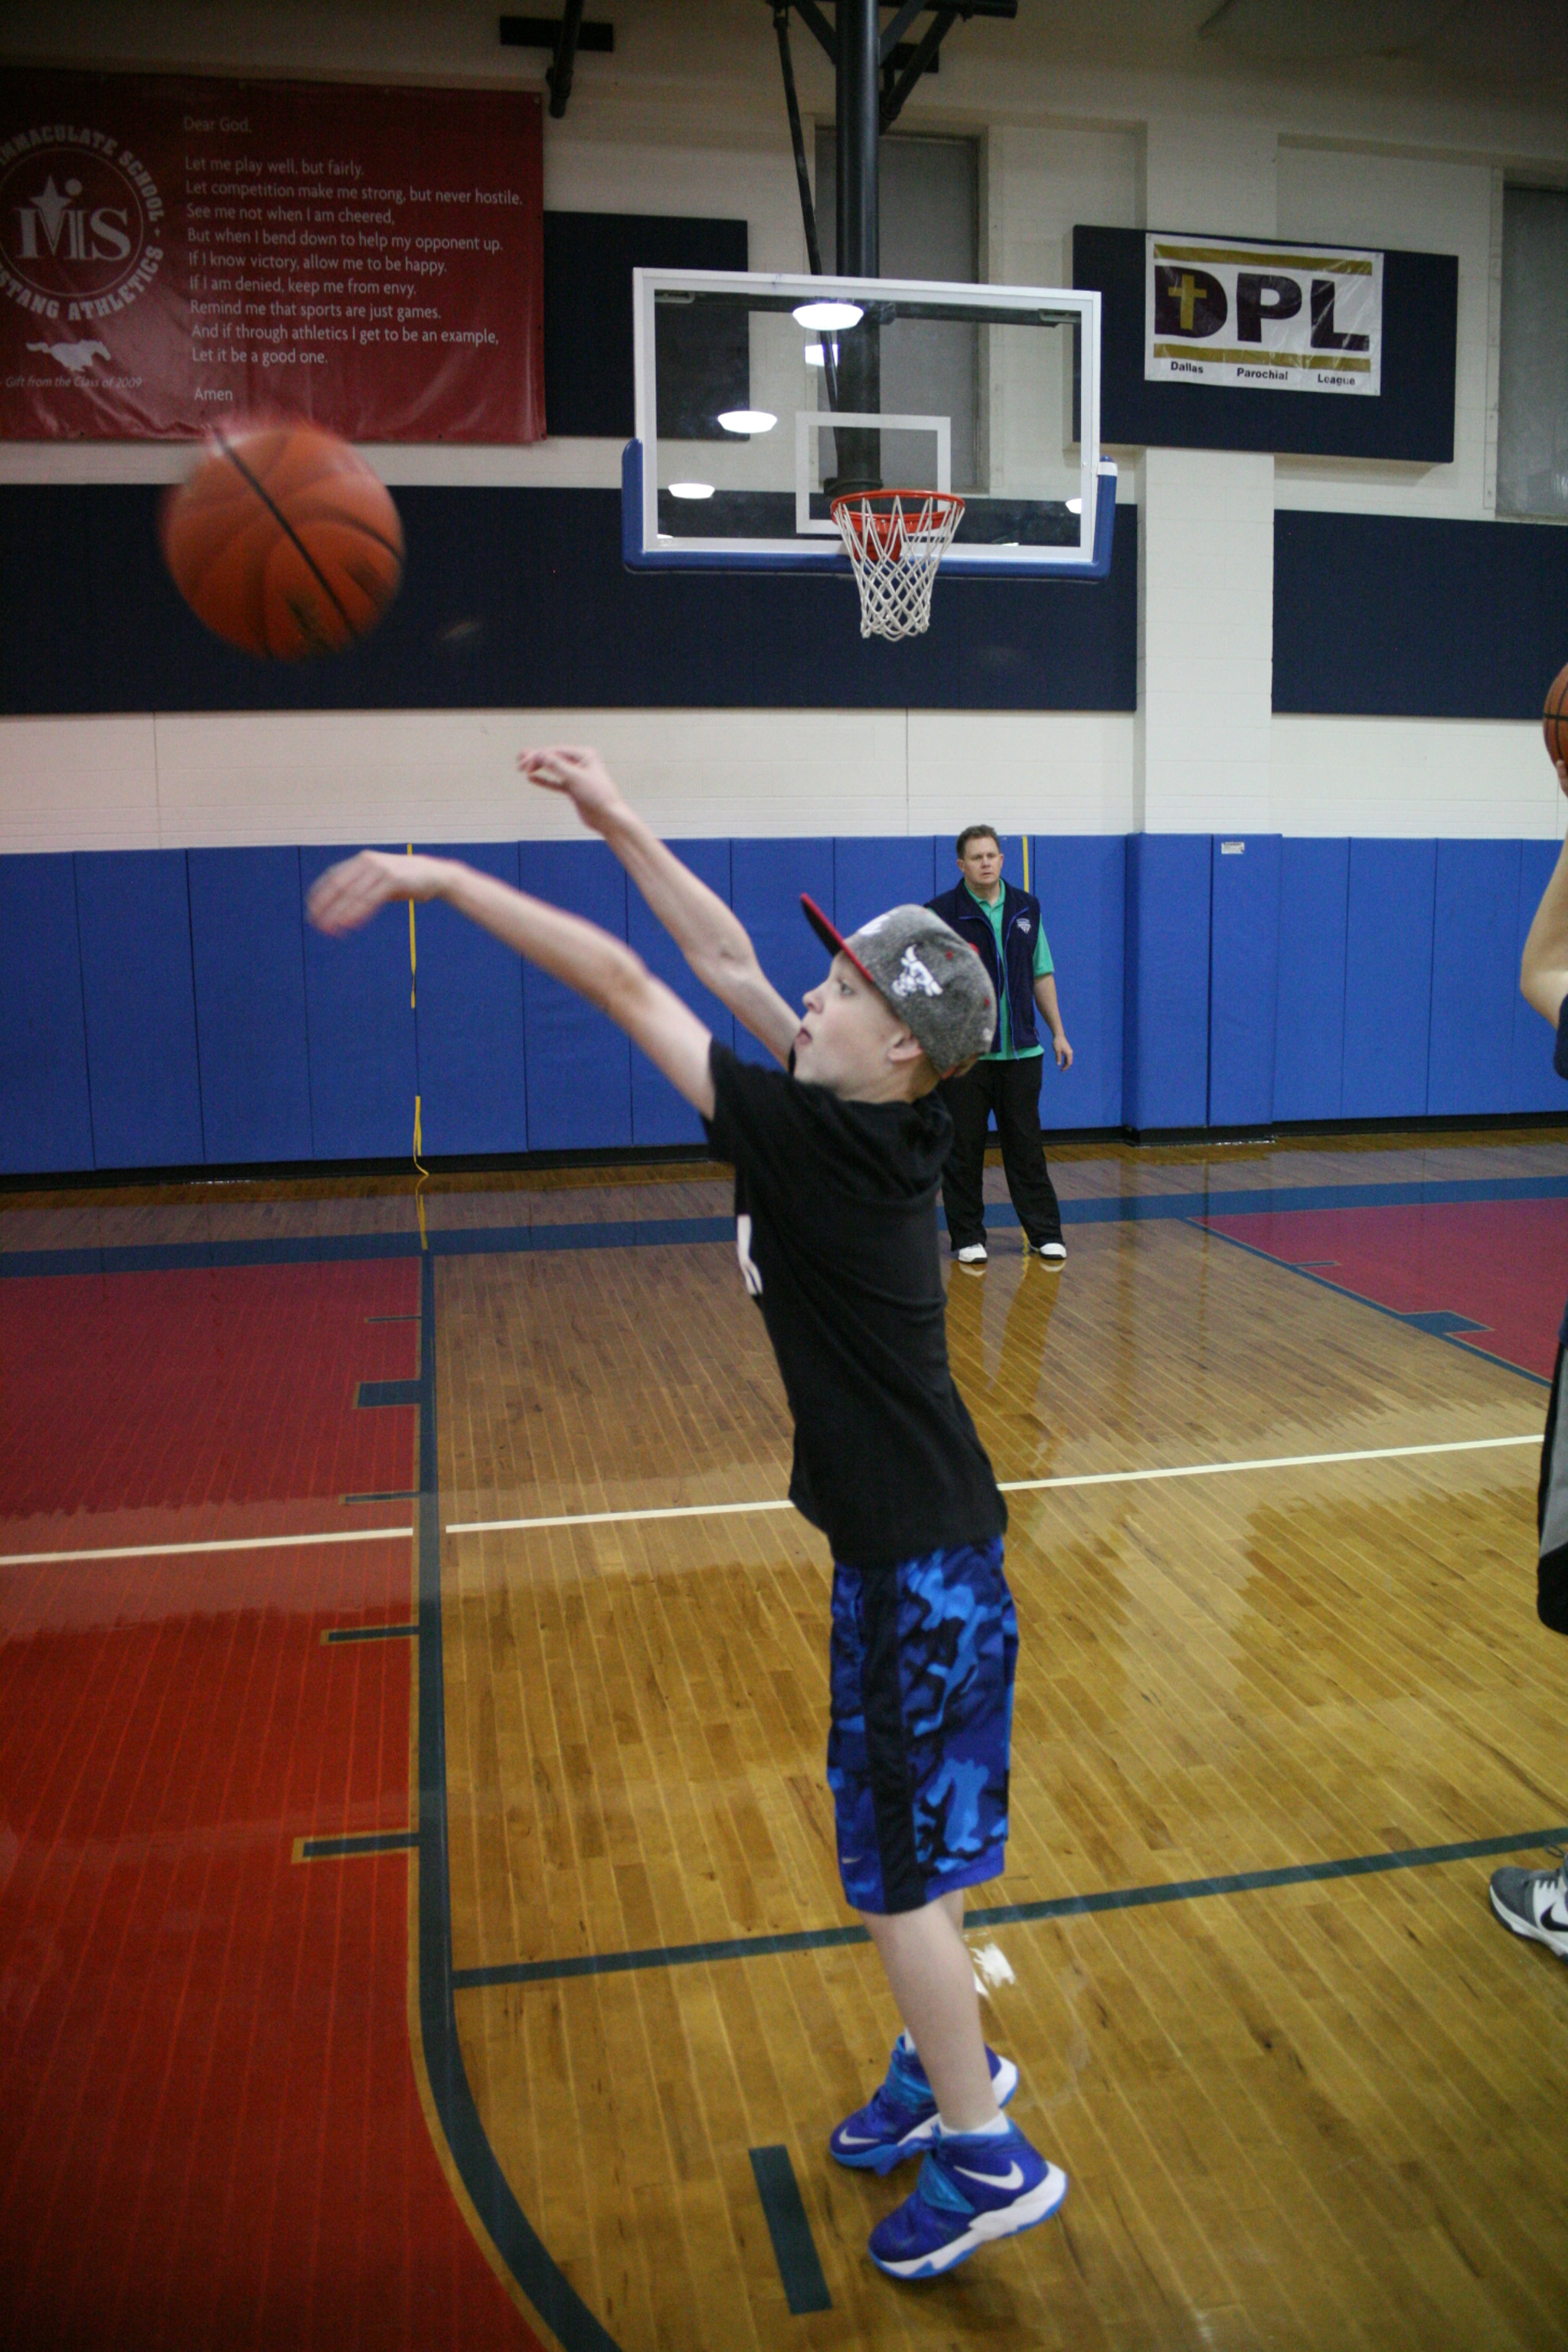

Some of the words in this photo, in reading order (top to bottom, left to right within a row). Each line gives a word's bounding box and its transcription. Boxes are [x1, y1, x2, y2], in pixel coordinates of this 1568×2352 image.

[184, 116, 214, 131] Dear
[185, 155, 206, 171] Let
[211, 158, 230, 171] me
[236, 155, 263, 176] play
[302, 158, 324, 175] but
[328, 159, 364, 180] fairly.
[119, 151, 165, 222] SCHOOL
[186, 180, 207, 194] Let
[211, 181, 294, 199] competition
[299, 182, 333, 198] make
[337, 187, 358, 199] me
[410, 185, 431, 201] but
[436, 191, 472, 203] never
[475, 188, 522, 205] hostile.
[187, 202, 211, 218] See
[215, 206, 235, 218] me
[240, 207, 263, 220] not
[267, 205, 302, 220] when
[307, 207, 310, 220] I
[315, 211, 335, 221] am
[338, 207, 395, 225] cheered,
[188, 227, 210, 242] But
[215, 227, 250, 243] when
[255, 230, 259, 243] I
[263, 230, 296, 244] bend
[300, 230, 337, 245] down
[341, 233, 355, 246] to
[359, 231, 388, 251] help
[392, 237, 411, 252] my
[416, 234, 480, 253] opponent
[484, 240, 503, 255] up.
[189, 250, 199, 266] If
[203, 252, 206, 265] I
[211, 251, 246, 266] know
[250, 254, 299, 273] victory,
[303, 253, 339, 269] allow
[343, 258, 364, 270] me
[368, 257, 382, 270] to
[386, 256, 401, 270] be
[406, 256, 447, 276] happy.
[0, 262, 60, 318] STANG
[68, 245, 164, 321] ATHLETICS
[190, 275, 200, 290] If
[204, 276, 207, 290] I
[211, 279, 230, 291] am
[289, 277, 319, 296] keep
[324, 282, 343, 293] me
[348, 278, 379, 294] from
[384, 283, 416, 299] envy.
[191, 299, 241, 315] Remind
[246, 304, 266, 315] me
[270, 300, 296, 316] that
[301, 303, 341, 320] sports
[346, 306, 366, 316] are
[370, 303, 393, 322] just
[397, 307, 441, 322] games.
[1155, 265, 1370, 351] DPL
[191, 323, 218, 338] And
[223, 323, 232, 338] if
[236, 324, 288, 344] through
[292, 325, 348, 340] athletics
[352, 326, 355, 340] I
[360, 328, 381, 345] get
[384, 328, 399, 341] to
[403, 326, 418, 341] be
[422, 330, 437, 341] an
[441, 328, 499, 348] example,
[192, 347, 213, 362] Let
[217, 348, 227, 362] it
[231, 347, 247, 362] be
[251, 351, 258, 362] a
[263, 348, 296, 368] good
[300, 351, 328, 364] one.
[5, 375, 25, 388] Gift
[29, 375, 52, 388] from
[55, 375, 71, 387] the
[74, 375, 100, 387] Class
[101, 376, 113, 387] of
[116, 376, 142, 388] 2009
[1170, 361, 1204, 374] Dallas
[1236, 367, 1288, 381] Parochial
[1318, 373, 1355, 386] League
[194, 387, 233, 400] Amen
